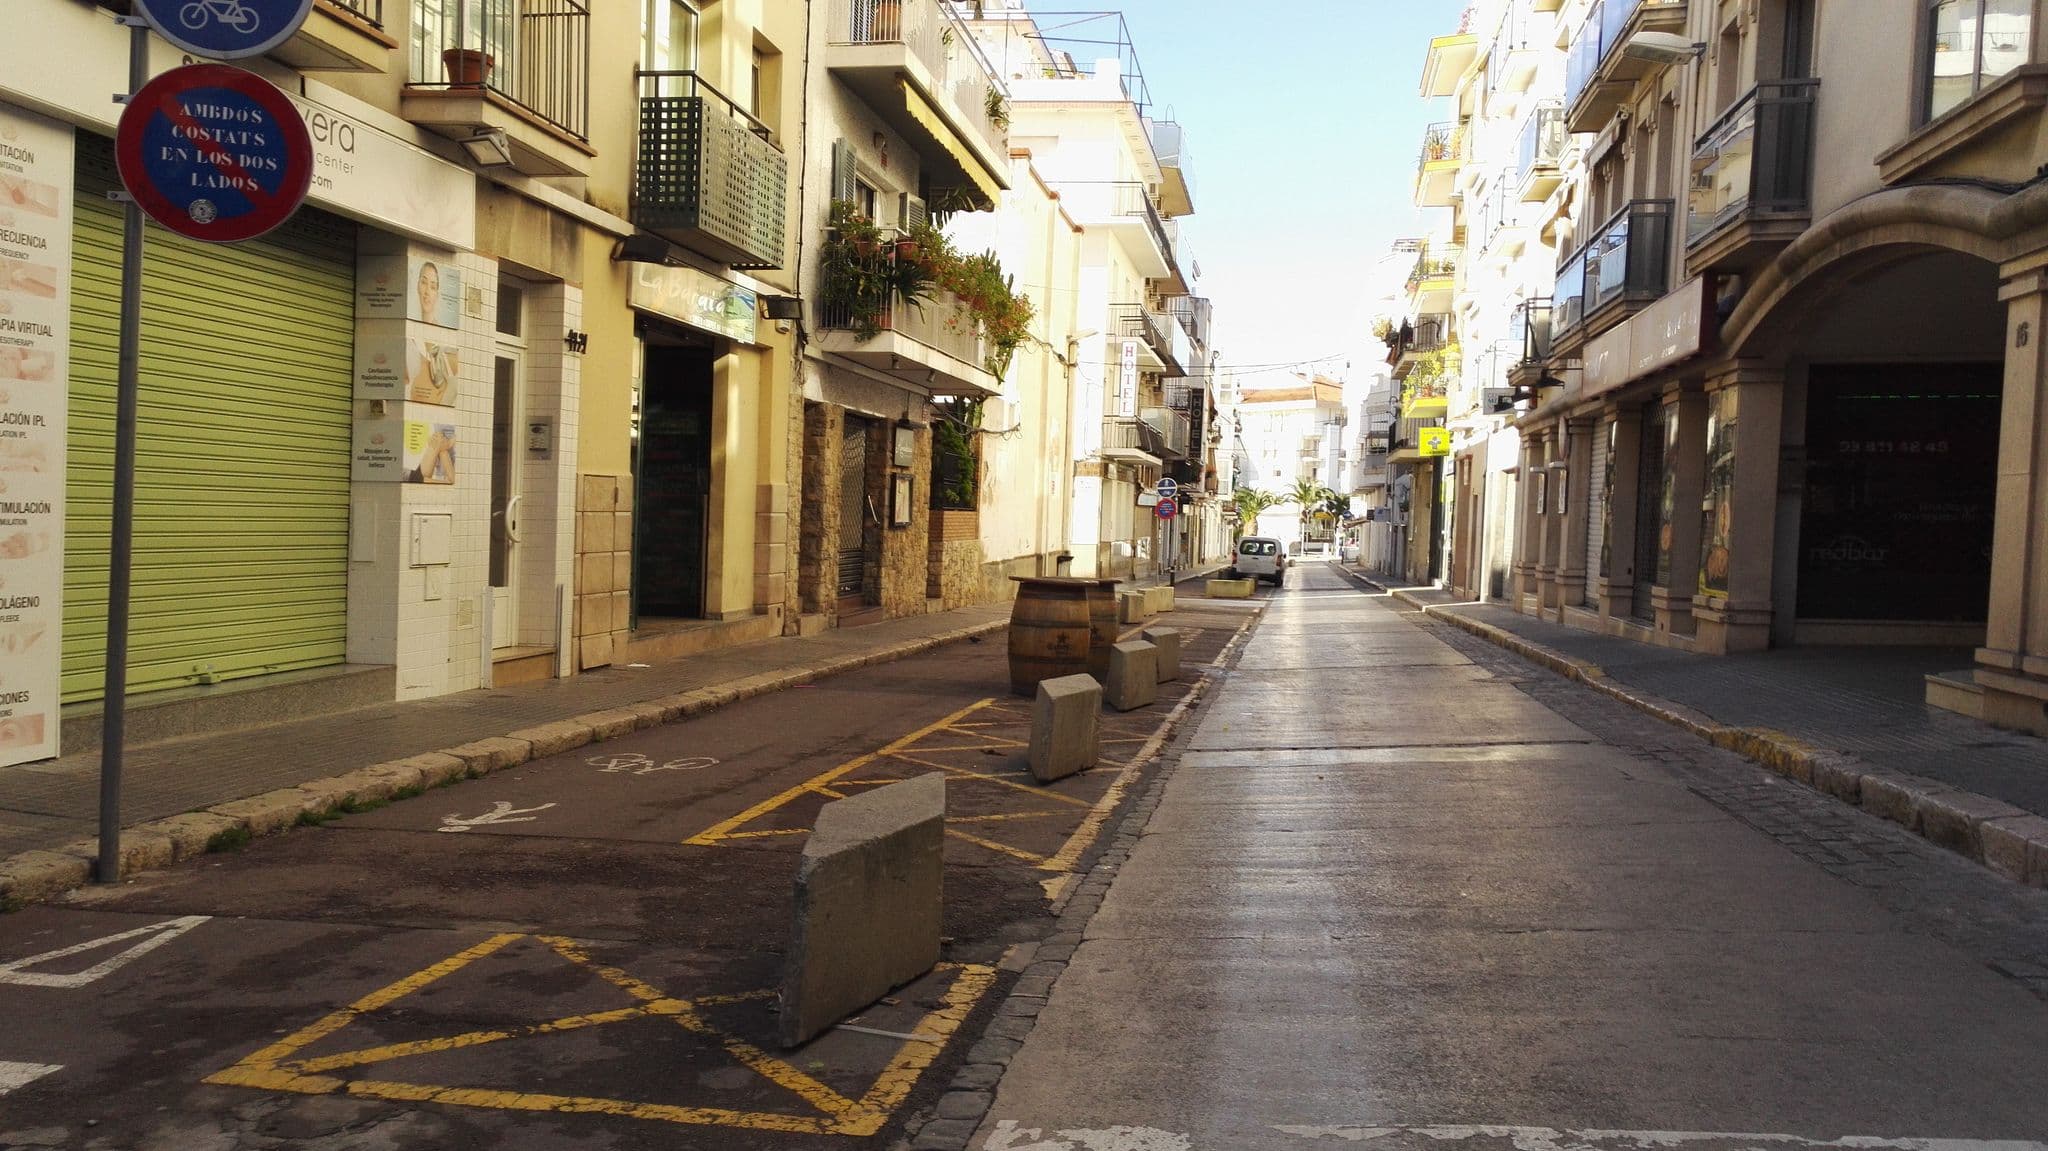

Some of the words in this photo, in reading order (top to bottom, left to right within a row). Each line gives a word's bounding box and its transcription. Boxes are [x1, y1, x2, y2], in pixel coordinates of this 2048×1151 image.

[172, 125, 266, 147] COSTATS
[160, 146, 189, 161] EN
[197, 149, 233, 166] LOS
[240, 153, 278, 171] DOS
[316, 152, 354, 175] center
[191, 172, 259, 192] LADOS
[17, 321, 54, 338] VIRTUAL
[2016, 321, 2029, 348] 16
[1122, 346, 1134, 413] HOTEL
[32, 414, 46, 427] IPL
[1191, 398, 1201, 449] HOTEL
